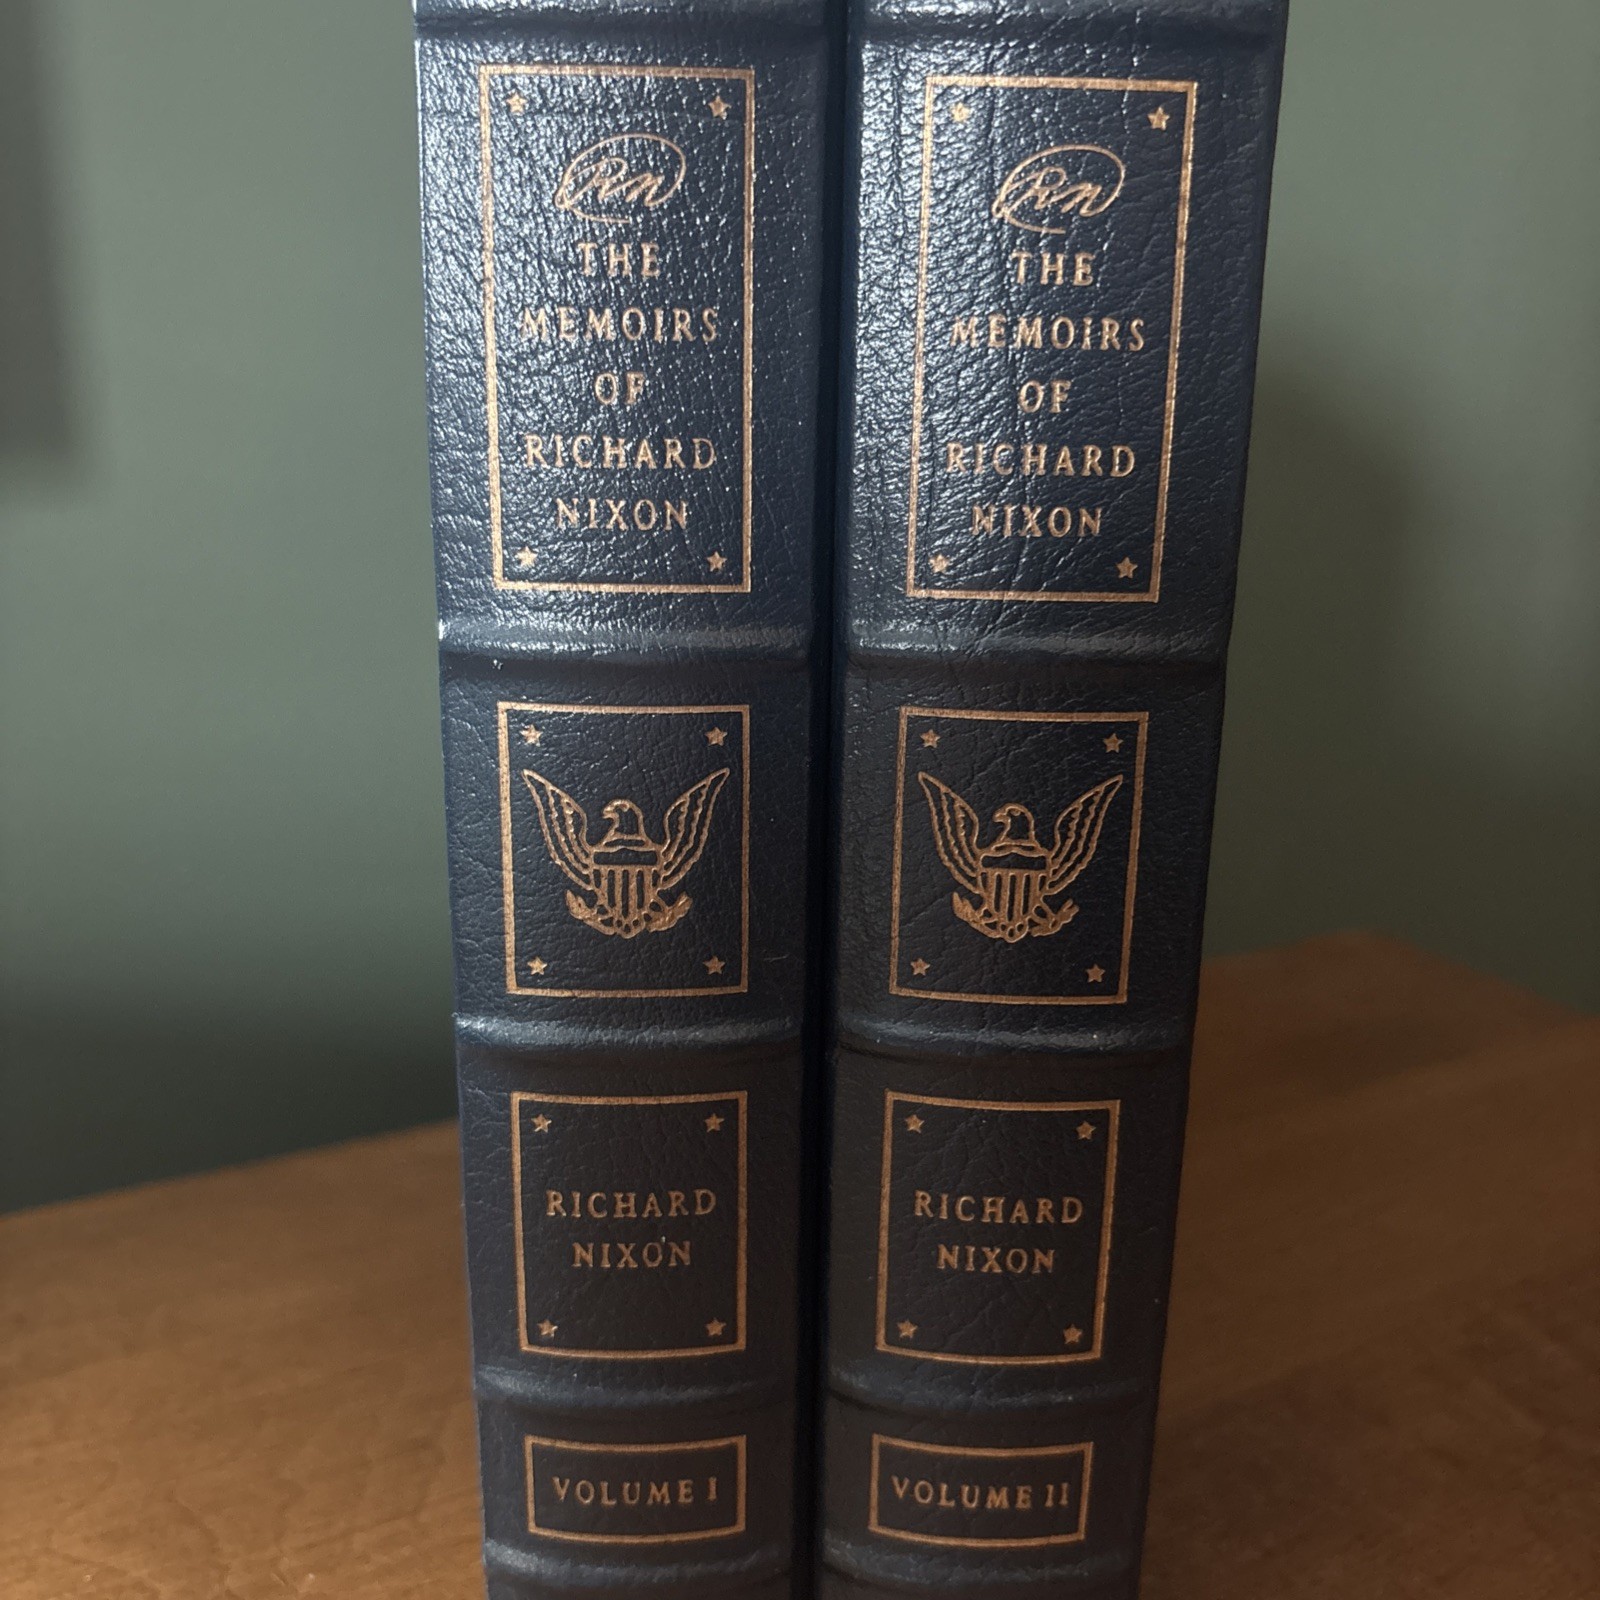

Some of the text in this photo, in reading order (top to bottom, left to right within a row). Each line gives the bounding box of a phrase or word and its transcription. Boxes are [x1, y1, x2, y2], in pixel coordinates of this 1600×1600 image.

[577, 242, 660, 277] THE
[1011, 250, 1095, 286] THE
[520, 306, 718, 342] MEMOIRS
[951, 314, 1145, 351] MEMOIRS
[595, 371, 647, 405] OF
[1018, 380, 1072, 413] OF
[524, 434, 716, 469] RICHARD
[947, 443, 1135, 477] RICHARD
[556, 498, 688, 531] NIXON
[971, 503, 1102, 538] NIXON
[546, 1188, 717, 1218] RICHARD
[914, 1189, 1084, 1224] RICHARD
[571, 1240, 691, 1268] NIXON
[937, 1244, 1055, 1274] NIXON
[552, 1476, 717, 1505] VOLUME I
[891, 1475, 1069, 1510] VOLUME II
